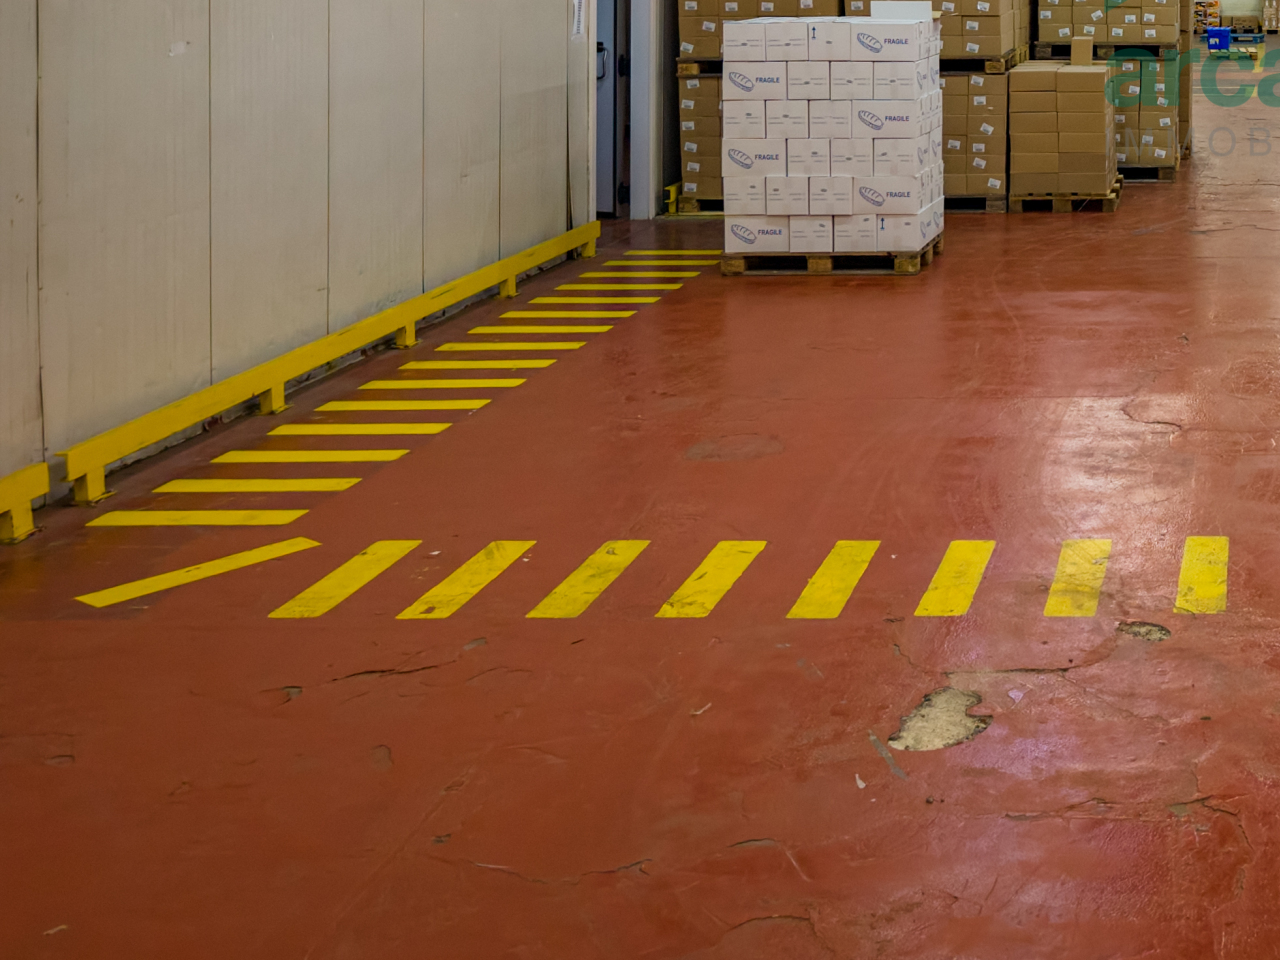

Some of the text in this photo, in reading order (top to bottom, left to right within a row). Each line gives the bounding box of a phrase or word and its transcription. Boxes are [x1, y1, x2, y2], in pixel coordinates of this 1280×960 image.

[883, 38, 909, 46] FRAGILE
[755, 76, 781, 84] FRAGILE
[884, 115, 910, 123] FRAGILE
[754, 153, 780, 161] FRAGILE
[885, 190, 911, 198] FRAGILE
[757, 228, 783, 236] FRAGILE
